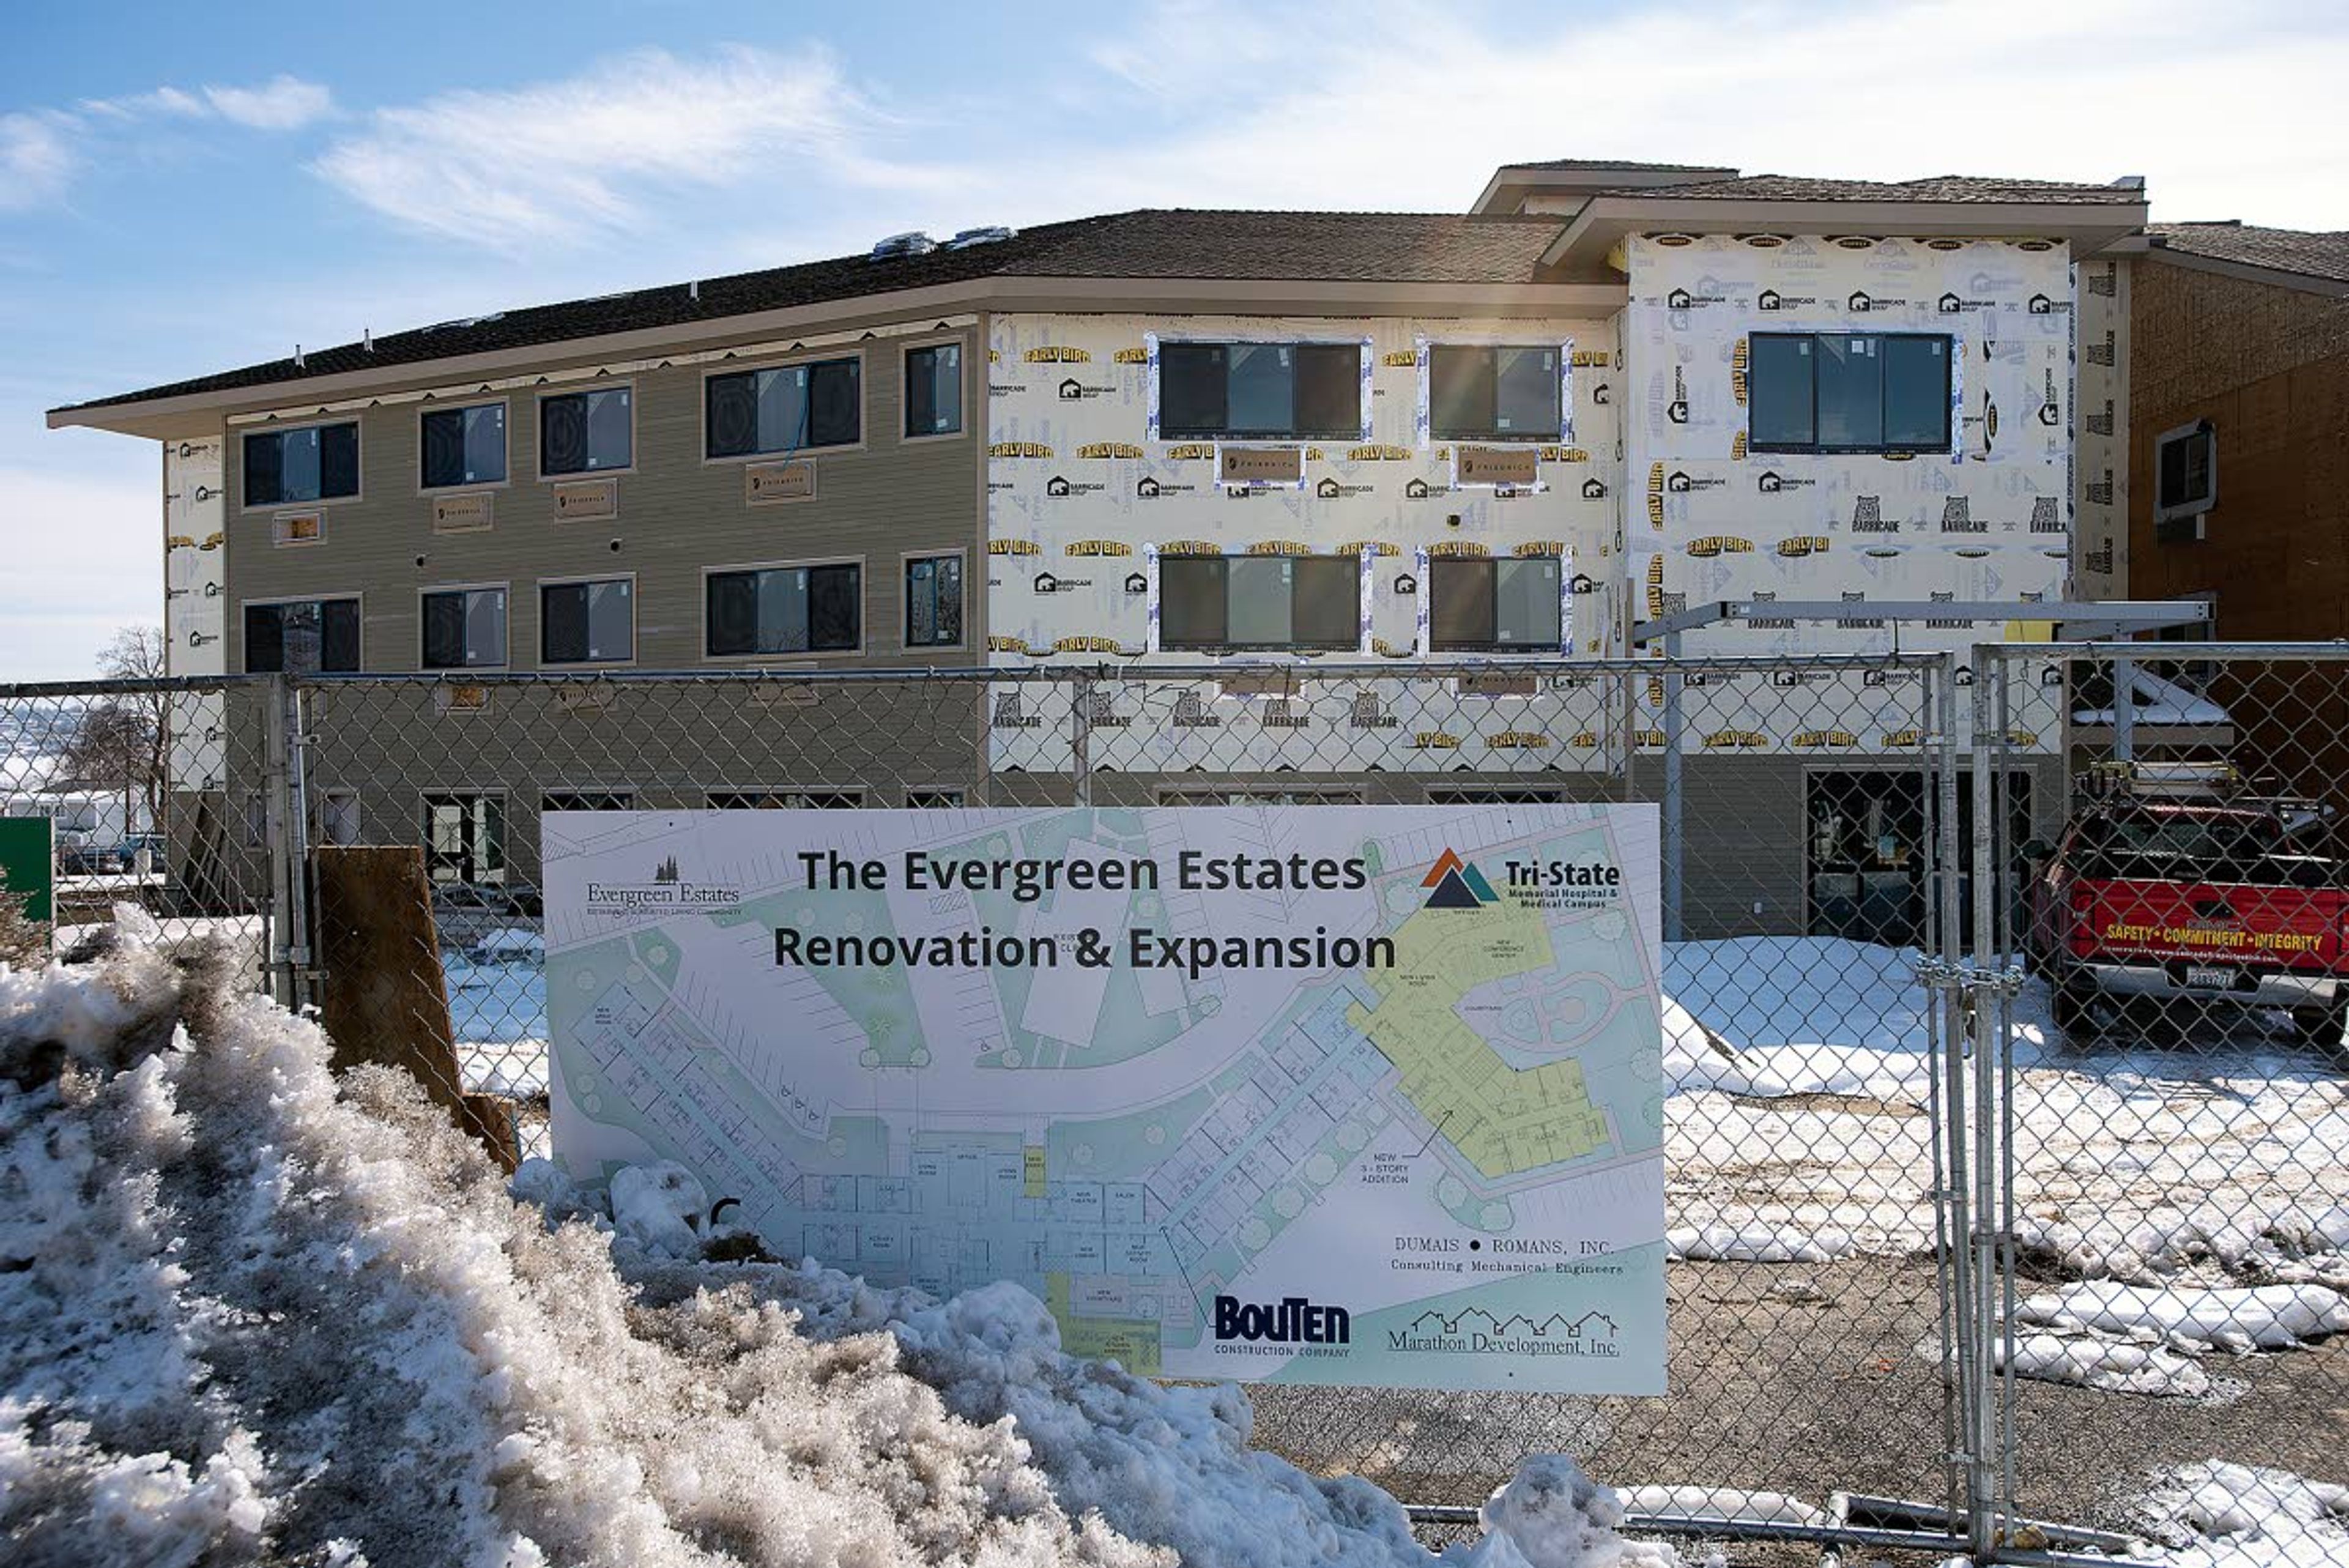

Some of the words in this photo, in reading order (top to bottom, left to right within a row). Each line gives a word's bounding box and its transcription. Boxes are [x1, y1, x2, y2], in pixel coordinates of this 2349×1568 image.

[1024, 347, 1059, 363] EARLY
[1060, 347, 1091, 363] BIRD
[1572, 351, 1591, 366] RLY
[1593, 351, 1608, 366] BI
[1732, 338, 1748, 368] BIRD
[1732, 371, 1748, 406] EARLY
[989, 442, 1023, 458] EARLY
[1025, 442, 1055, 458] BIRD
[1077, 444, 1112, 459] EARLY
[1113, 444, 1145, 459] BIRD
[1167, 444, 1203, 459] EARLY
[1306, 446, 1324, 461] RD
[1347, 446, 1382, 461] EARLY
[1384, 446, 1412, 461] BIRD
[1732, 431, 1748, 461] BIRD
[1560, 447, 1589, 463] BIRD
[1649, 461, 1664, 492] BIRD
[1648, 494, 1664, 531] EARLY
[1852, 521, 1899, 533] BARRICADE
[1940, 521, 1989, 533] BARRICADE
[2030, 521, 2067, 533] BARRICA
[1011, 539, 1042, 557] BIRD
[1065, 540, 1100, 556] EARLY
[1100, 540, 1132, 557] BIRD
[1193, 541, 1222, 555] BIRD
[1460, 543, 1490, 556] BIRD
[1513, 543, 1548, 558] EARLY
[1549, 542, 1578, 557] BID
[1687, 537, 1723, 553] EARLY
[1724, 535, 1754, 552] BIRD
[1777, 537, 1813, 553] EARLY
[1814, 536, 1829, 552] BI
[1648, 554, 1663, 584] BIRD
[1647, 585, 1663, 621] EARLY
[1000, 636, 1030, 653] BIRD
[1053, 637, 1089, 653] EARLY
[1091, 637, 1120, 653] BIRD
[993, 716, 1042, 727] BARRICADE
[1173, 716, 1220, 727] BARRICADE
[1263, 716, 1310, 727] BARRICADE
[1351, 716, 1398, 727] BARRICADE
[1484, 734, 1520, 748] EARLY
[1574, 732, 1596, 748] EAR
[1701, 732, 1737, 746] EARLY
[1739, 732, 1768, 746] BIRD
[1792, 732, 1827, 746] EARLY
[1828, 732, 1858, 746] BIRD
[798, 850, 886, 890] The
[905, 852, 1159, 902] Evergreen
[1179, 851, 1366, 890] Estates
[1505, 861, 1620, 886] Tri-State
[588, 883, 672, 908] Evergreen
[680, 883, 740, 902] Estates
[1509, 889, 1559, 898] Memorial
[1562, 889, 1606, 899] Hospital
[1609, 889, 1618, 897] &
[1521, 899, 1562, 908] Medical
[1565, 899, 1606, 909] Campus
[2107, 924, 2153, 941] SAFETY
[2162, 927, 2246, 946] COMMITMENT
[2254, 933, 2323, 951] INTEGRITY
[774, 926, 1058, 967] Renovation
[1075, 928, 1113, 968] &
[1130, 926, 1395, 980] Expansion
[1362, 1175, 1409, 1184] ADDITION
[1395, 1238, 1460, 1252] DUMAIS
[1493, 1239, 1567, 1255] ROMANS,
[1581, 1241, 1615, 1254] INC.
[1391, 1259, 1463, 1273] Consulting
[1471, 1260, 1546, 1273] Mechanical
[1556, 1263, 1624, 1276] Engineers
[1215, 1345, 1293, 1356] CONSTRUCTION
[1299, 1347, 1350, 1358] COMPANY
[1388, 1331, 1466, 1350] Marathon
[1472, 1333, 1585, 1356] Development,
[1590, 1339, 1620, 1356] Inc.
